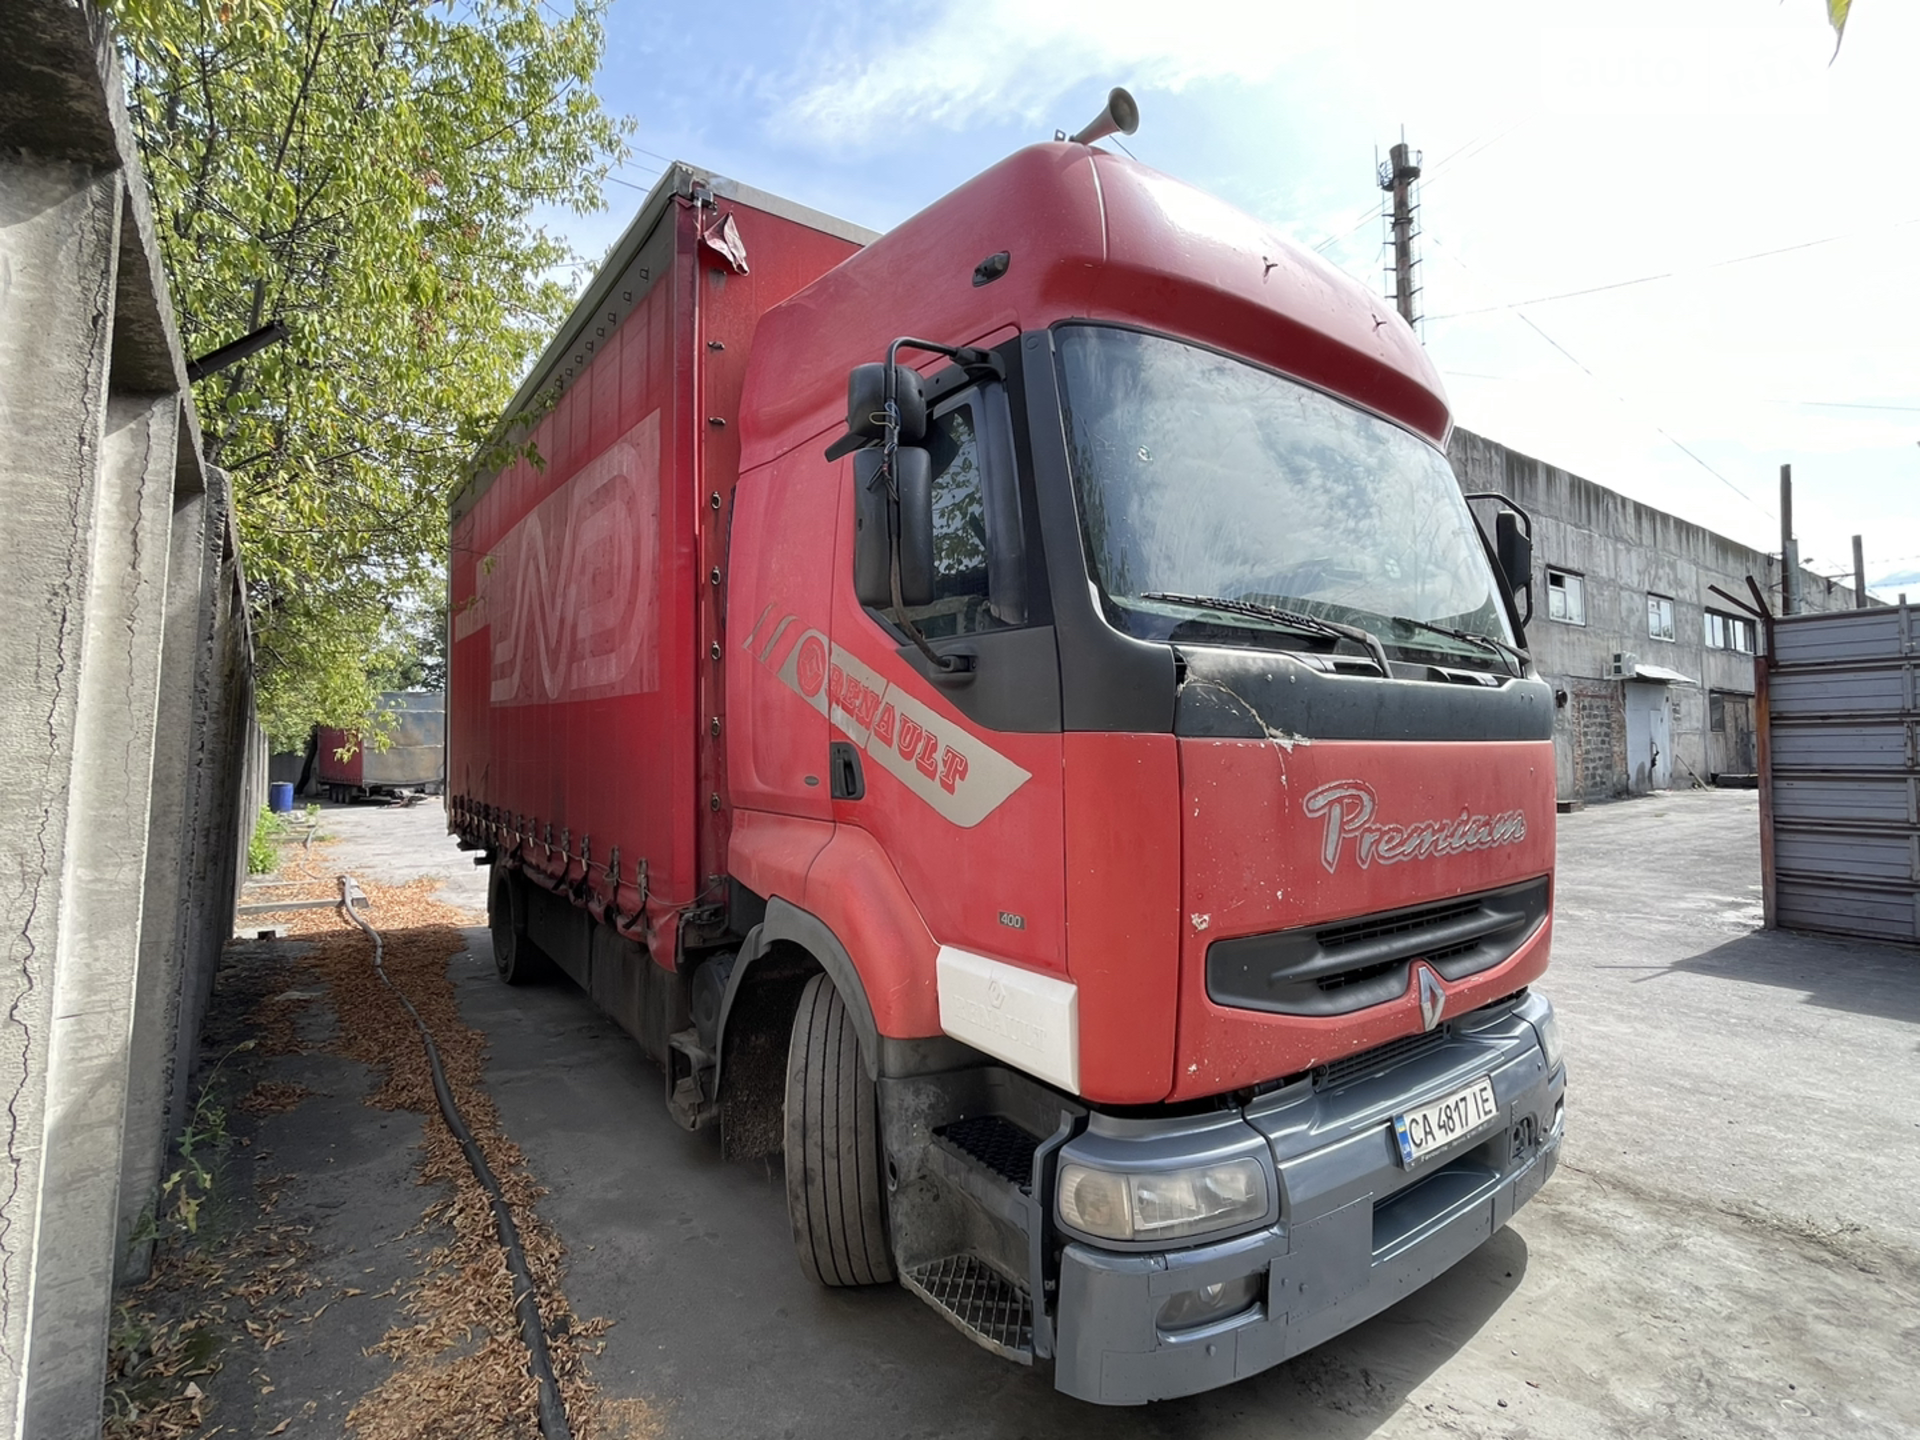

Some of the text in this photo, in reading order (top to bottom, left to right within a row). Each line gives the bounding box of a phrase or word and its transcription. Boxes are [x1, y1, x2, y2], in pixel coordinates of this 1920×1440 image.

[825, 662, 969, 796] RENAULT
[1303, 779, 1527, 875] Premium
[1000, 912, 1022, 929] 400
[1408, 1112, 1437, 1149] CA
[1436, 1095, 1469, 1137] 4817
[1472, 1086, 1493, 1121] IE
